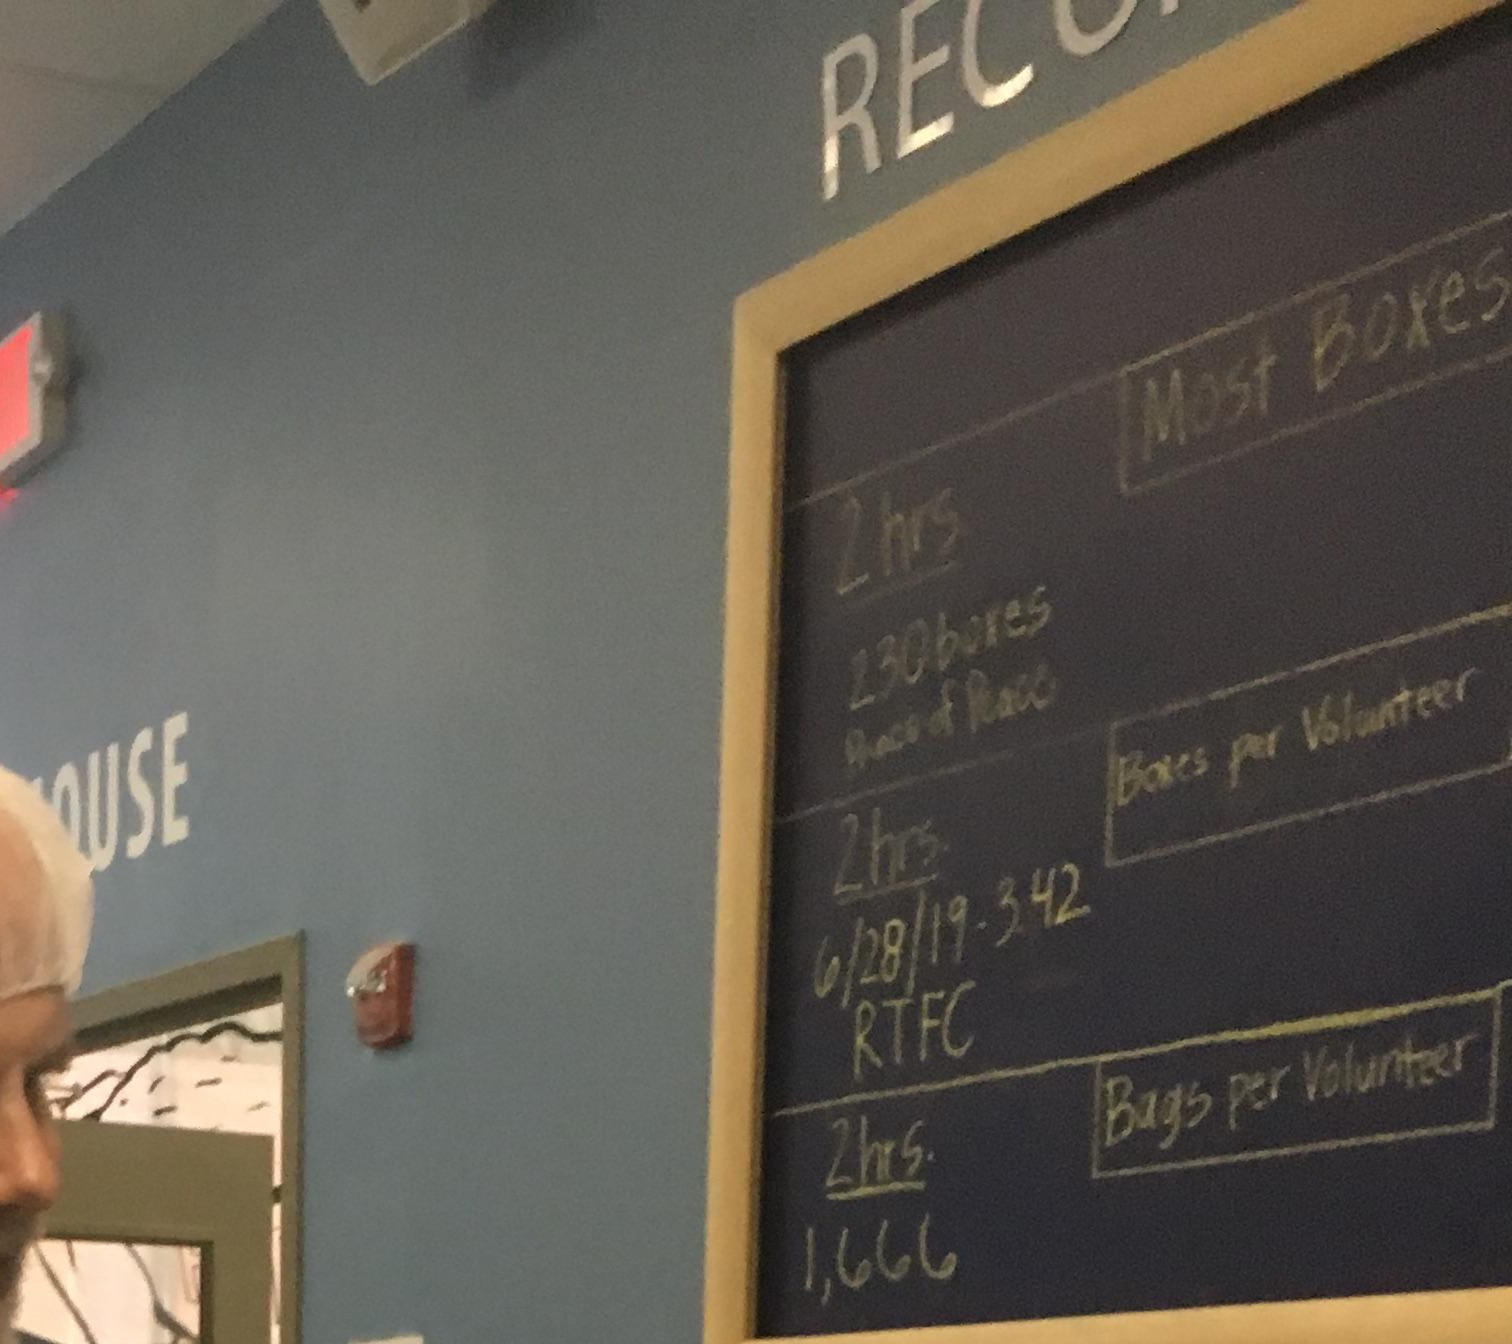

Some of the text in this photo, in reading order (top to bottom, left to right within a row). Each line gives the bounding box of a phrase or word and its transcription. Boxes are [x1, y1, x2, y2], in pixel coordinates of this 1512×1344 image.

[1310, 247, 1511, 392] Boxes
[1300, 667, 1481, 753] Volunteer
[30, 711, 188, 873] OUSE
[1103, 1031, 1478, 1151] Bags per Volunteer
